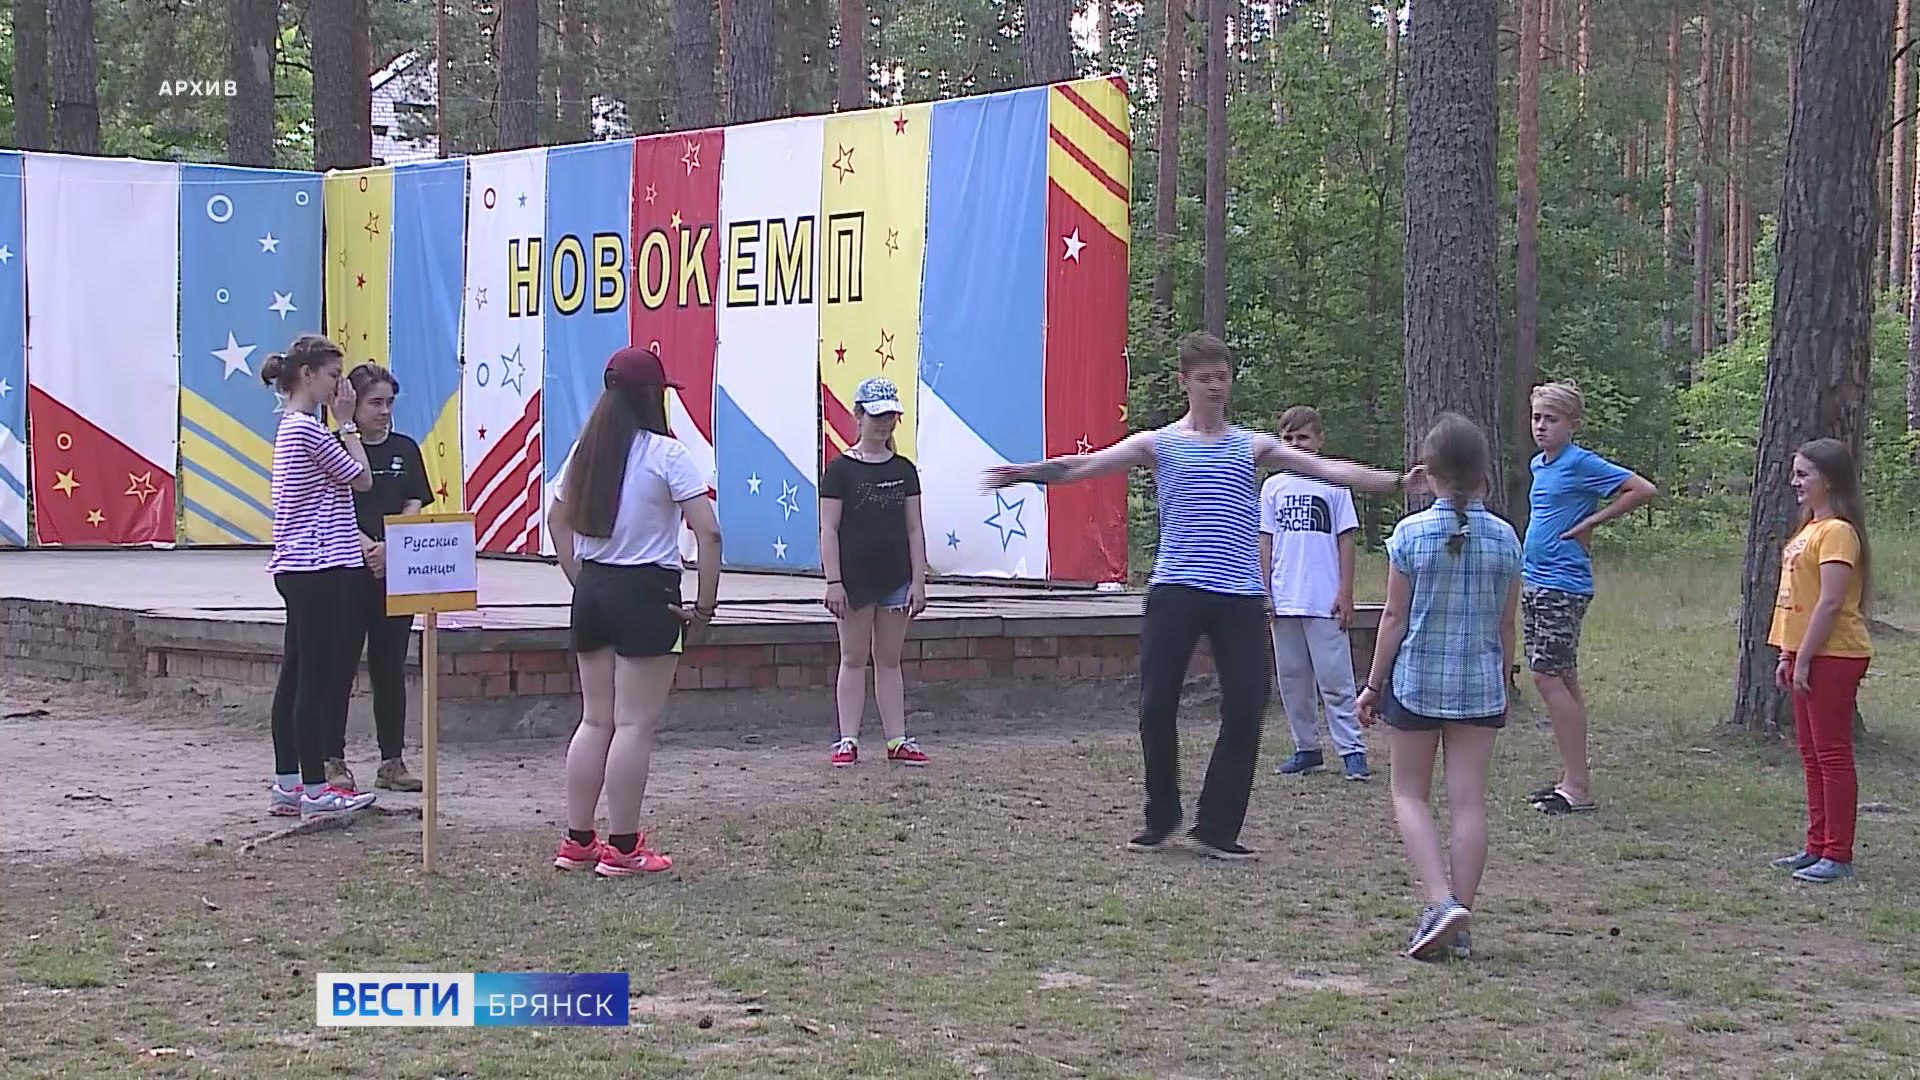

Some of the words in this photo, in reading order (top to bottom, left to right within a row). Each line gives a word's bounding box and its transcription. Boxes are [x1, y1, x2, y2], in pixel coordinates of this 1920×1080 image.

[508, 211, 865, 319] НОВОКЕМП
[1284, 494, 1310, 506] THE
[1275, 507, 1310, 522] ORTH
[403, 536, 459, 552] Русские
[408, 563, 456, 576] танцы
